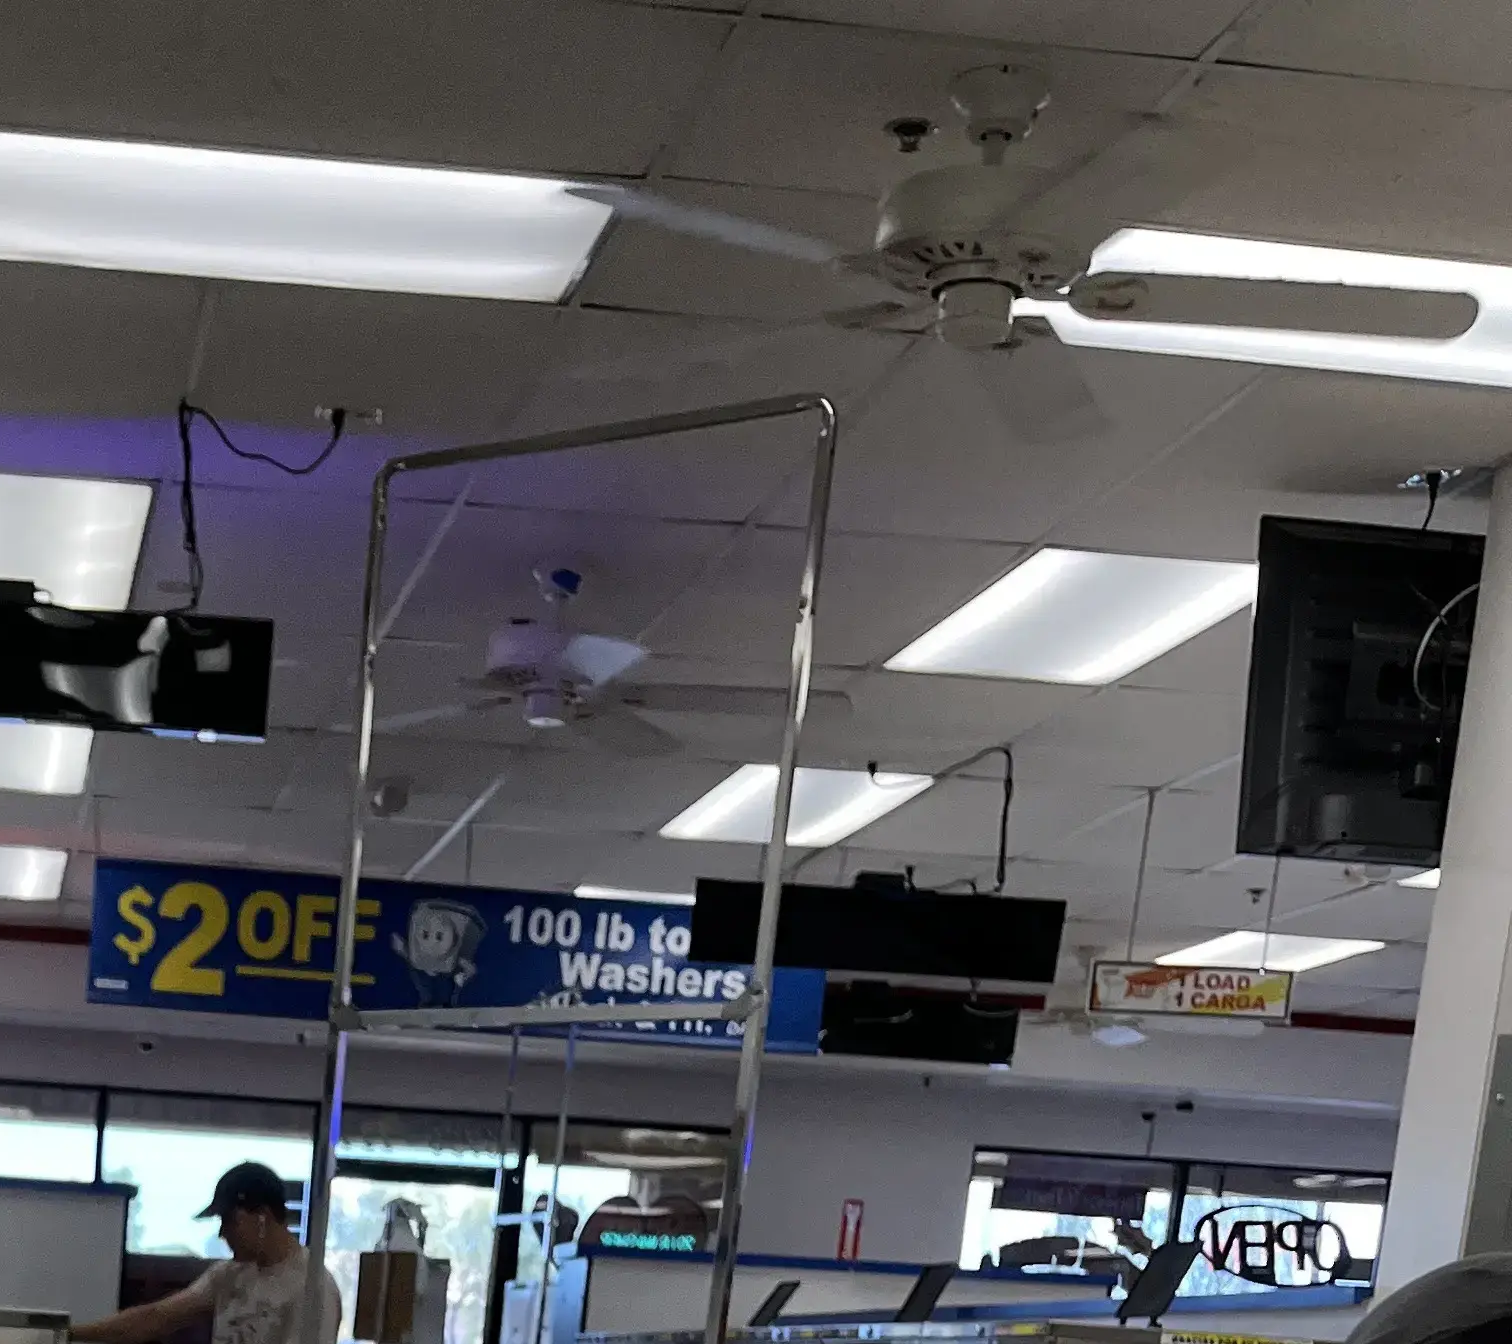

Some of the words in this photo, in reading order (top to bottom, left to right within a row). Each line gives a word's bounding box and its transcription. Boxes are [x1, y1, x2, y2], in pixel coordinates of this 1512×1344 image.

[112, 880, 230, 997] $2
[236, 889, 382, 963] OFF
[503, 904, 582, 948] 100
[593, 911, 636, 952] lb
[647, 915, 692, 956] to
[558, 950, 747, 1000] Washers
[1192, 974, 1251, 992] LOAD
